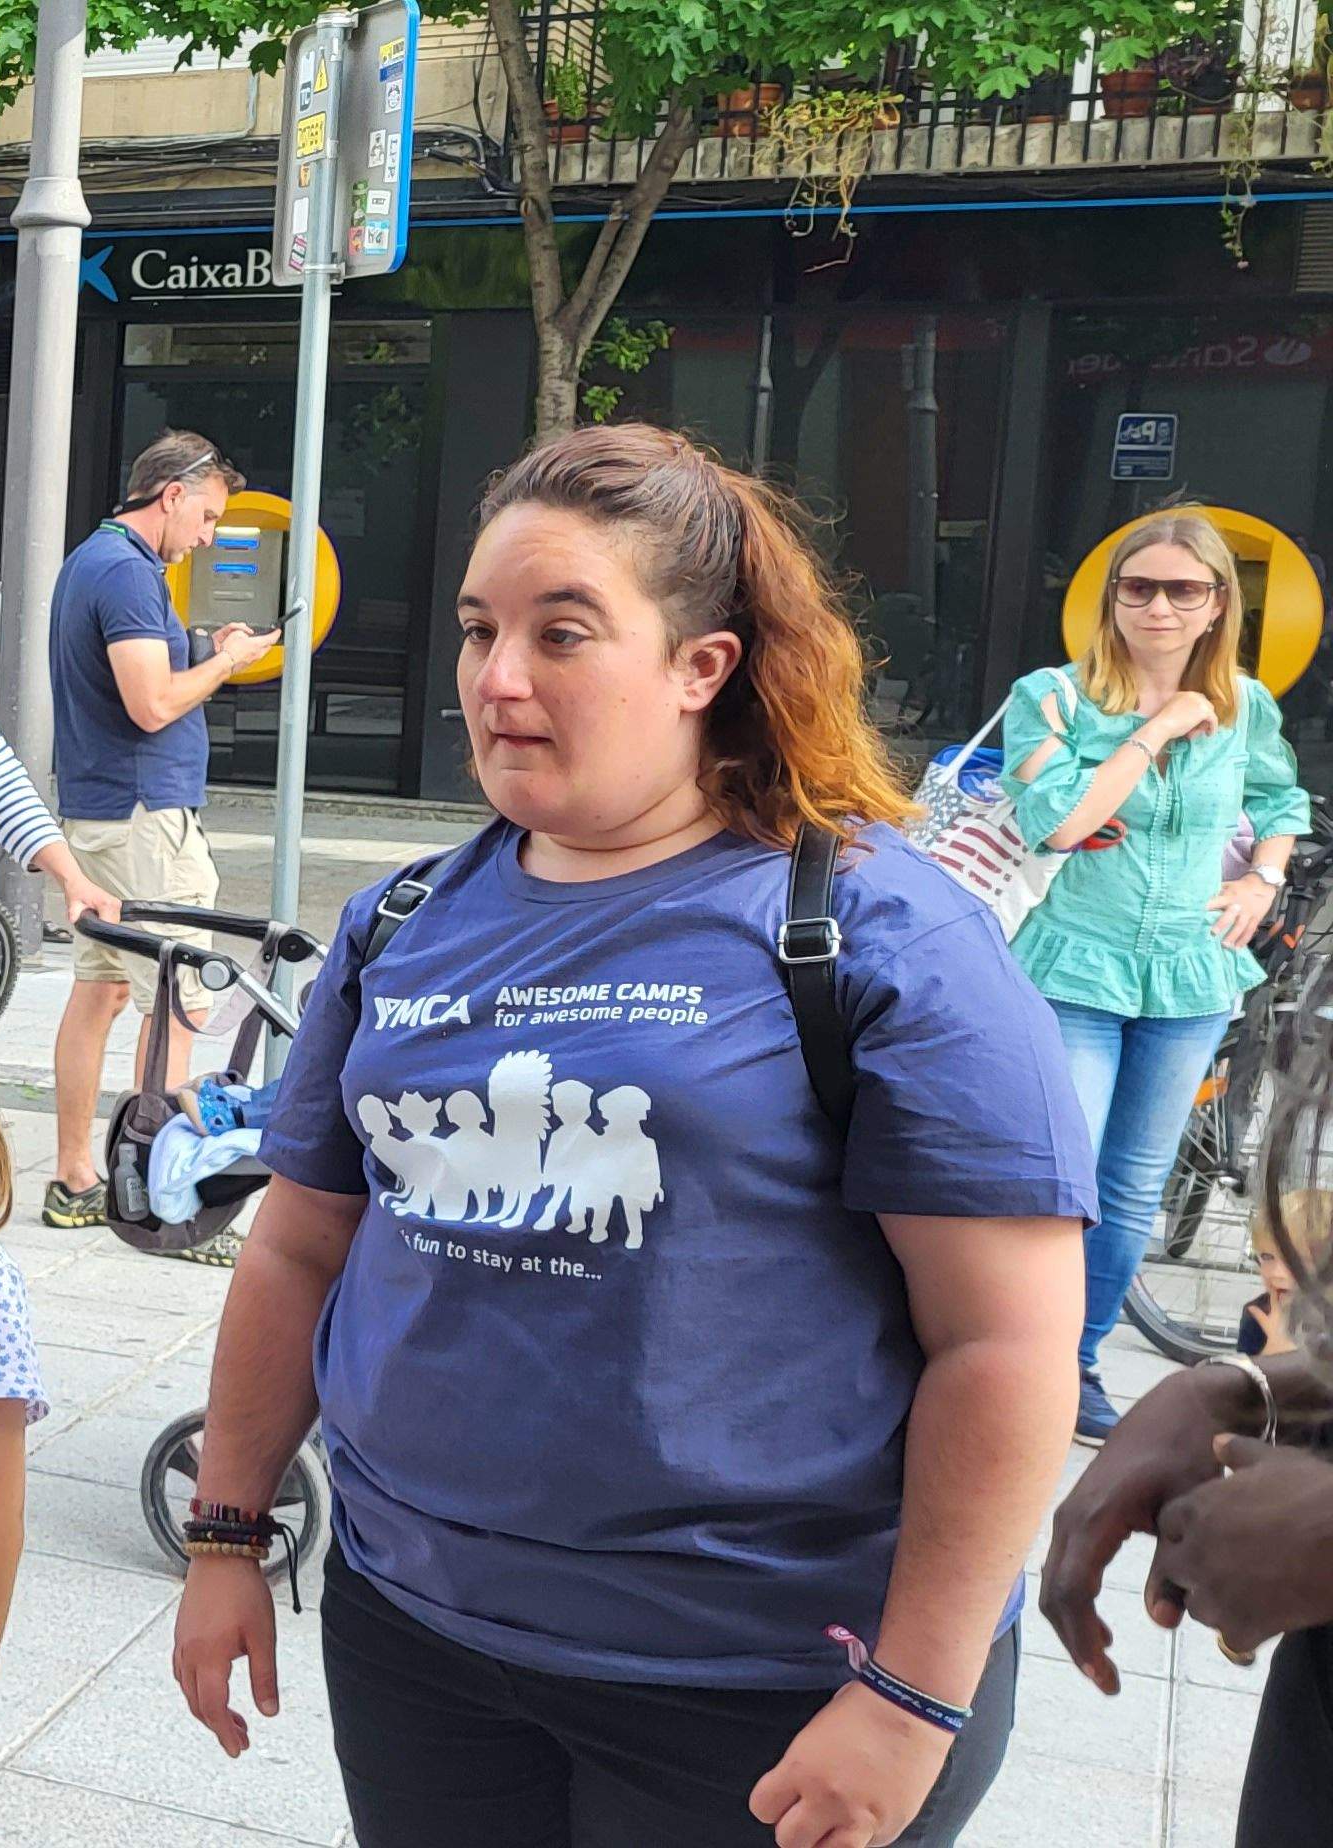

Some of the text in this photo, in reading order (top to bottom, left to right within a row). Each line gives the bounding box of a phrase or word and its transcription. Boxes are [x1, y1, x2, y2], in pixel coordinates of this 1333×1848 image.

[131, 249, 272, 290] CaixaB
[374, 994, 472, 1031] YMCA
[495, 982, 704, 1007] AWESOME CAMPS
[494, 1005, 709, 1028] for awesome people
[414, 1232, 441, 1256] fun
[446, 1240, 467, 1260] to
[472, 1248, 513, 1273] stay
[521, 1257, 542, 1273] at
[549, 1256, 603, 1281] the...
